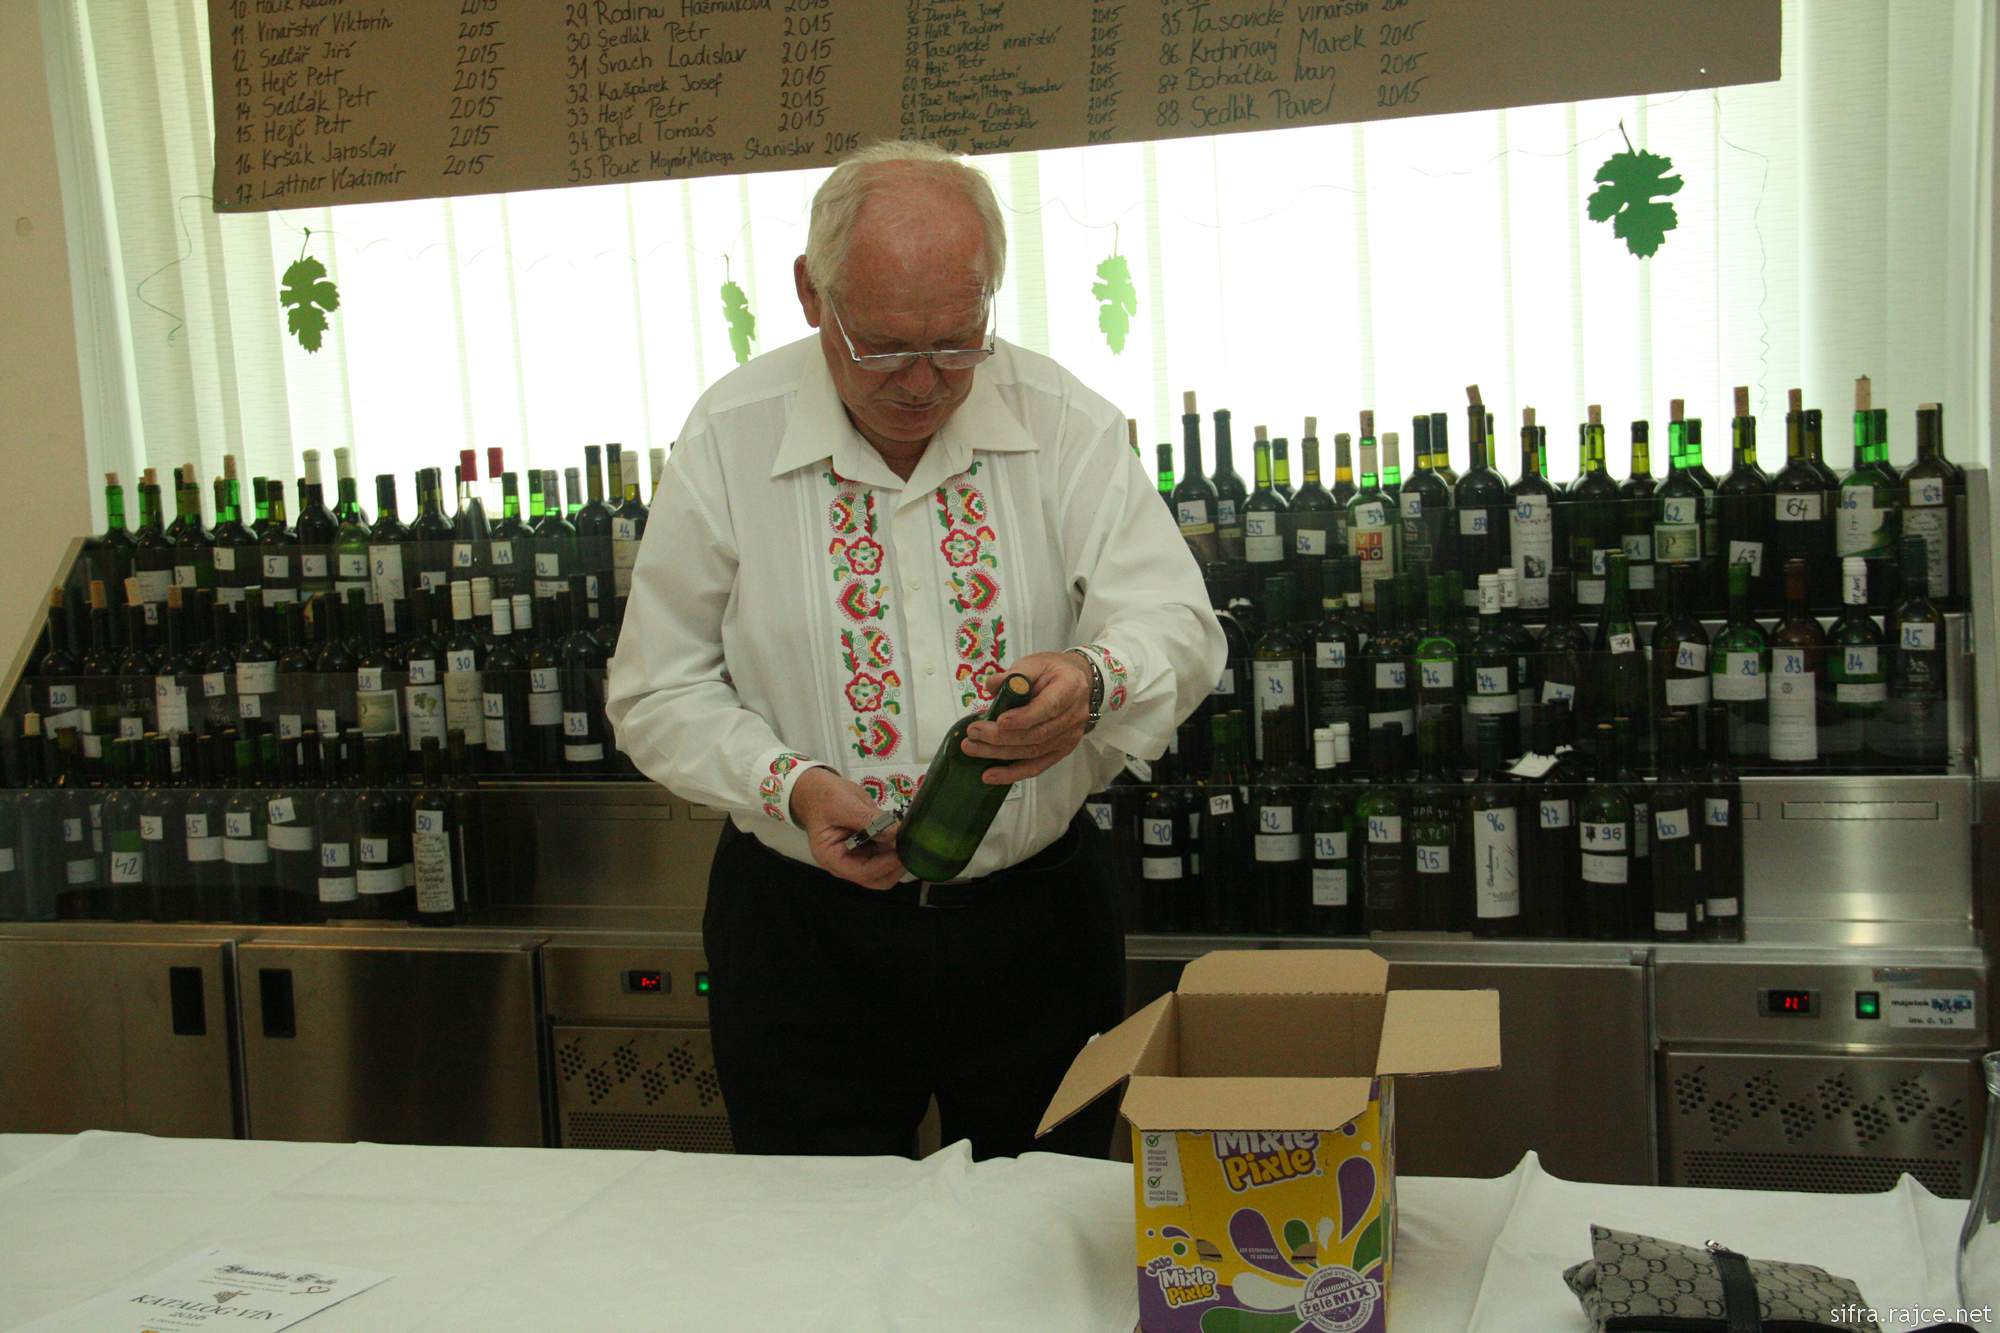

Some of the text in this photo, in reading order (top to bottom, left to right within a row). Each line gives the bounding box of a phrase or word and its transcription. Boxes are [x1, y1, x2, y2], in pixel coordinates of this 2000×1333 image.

[594, 0, 665, 25] Rodina
[458, 21, 499, 39] 2015
[598, 25, 651, 49] Sedlák
[664, 21, 711, 43] Petr
[784, 13, 833, 36] 2015
[1300, 26, 1366, 54] Marek
[1379, 20, 1427, 48] 2015
[668, 43, 746, 68] Ladislav
[782, 38, 834, 64] 2015
[307, 66, 344, 87] Petr
[457, 43, 504, 65] 2015
[1294, 57, 1336, 83] Ivan
[1380, 52, 1430, 76] 2015
[680, 72, 723, 97] Josef
[780, 65, 832, 88] 2015
[263, 67, 504, 118] Sedlák Petr 2015
[1190, 91, 1259, 128] Sedlák
[1269, 84, 1336, 120] Pavel
[1376, 75, 1430, 108] 2015
[315, 114, 352, 136] Petr
[449, 97, 503, 119] 2015
[598, 104, 635, 126] Hejč
[645, 96, 689, 118] Petr
[780, 88, 826, 110] 2015
[594, 122, 642, 152] Brhel
[654, 115, 718, 142] Tomáš
[777, 106, 831, 132] 2015
[322, 136, 397, 163] Jaroslav
[449, 126, 499, 148] 2015
[744, 137, 815, 160] Stanislav
[824, 131, 861, 154] 2015
[442, 155, 495, 176] 2015
[1516, 501, 1532, 519] 60
[1664, 501, 1683, 522] 62
[1786, 497, 1808, 521] 64
[1248, 519, 1265, 535] 55
[268, 557, 278, 575] 5
[376, 560, 384, 576] 8
[457, 657, 470, 671] 30
[1679, 648, 1694, 666] 81
[1784, 655, 1801, 673] 83
[570, 717, 584, 732] 33
[418, 815, 432, 831] 50
[1152, 823, 1171, 843] 90
[1369, 819, 1388, 841] 94
[1486, 812, 1504, 832] 96
[1316, 837, 1336, 857] 93
[1418, 848, 1440, 870] 95
[1222, 1146, 1315, 1192] Pixle
[1160, 1266, 1216, 1289] Mixle
[130, 1294, 237, 1316] KATALOG
[1166, 1283, 1214, 1306] Pixle
